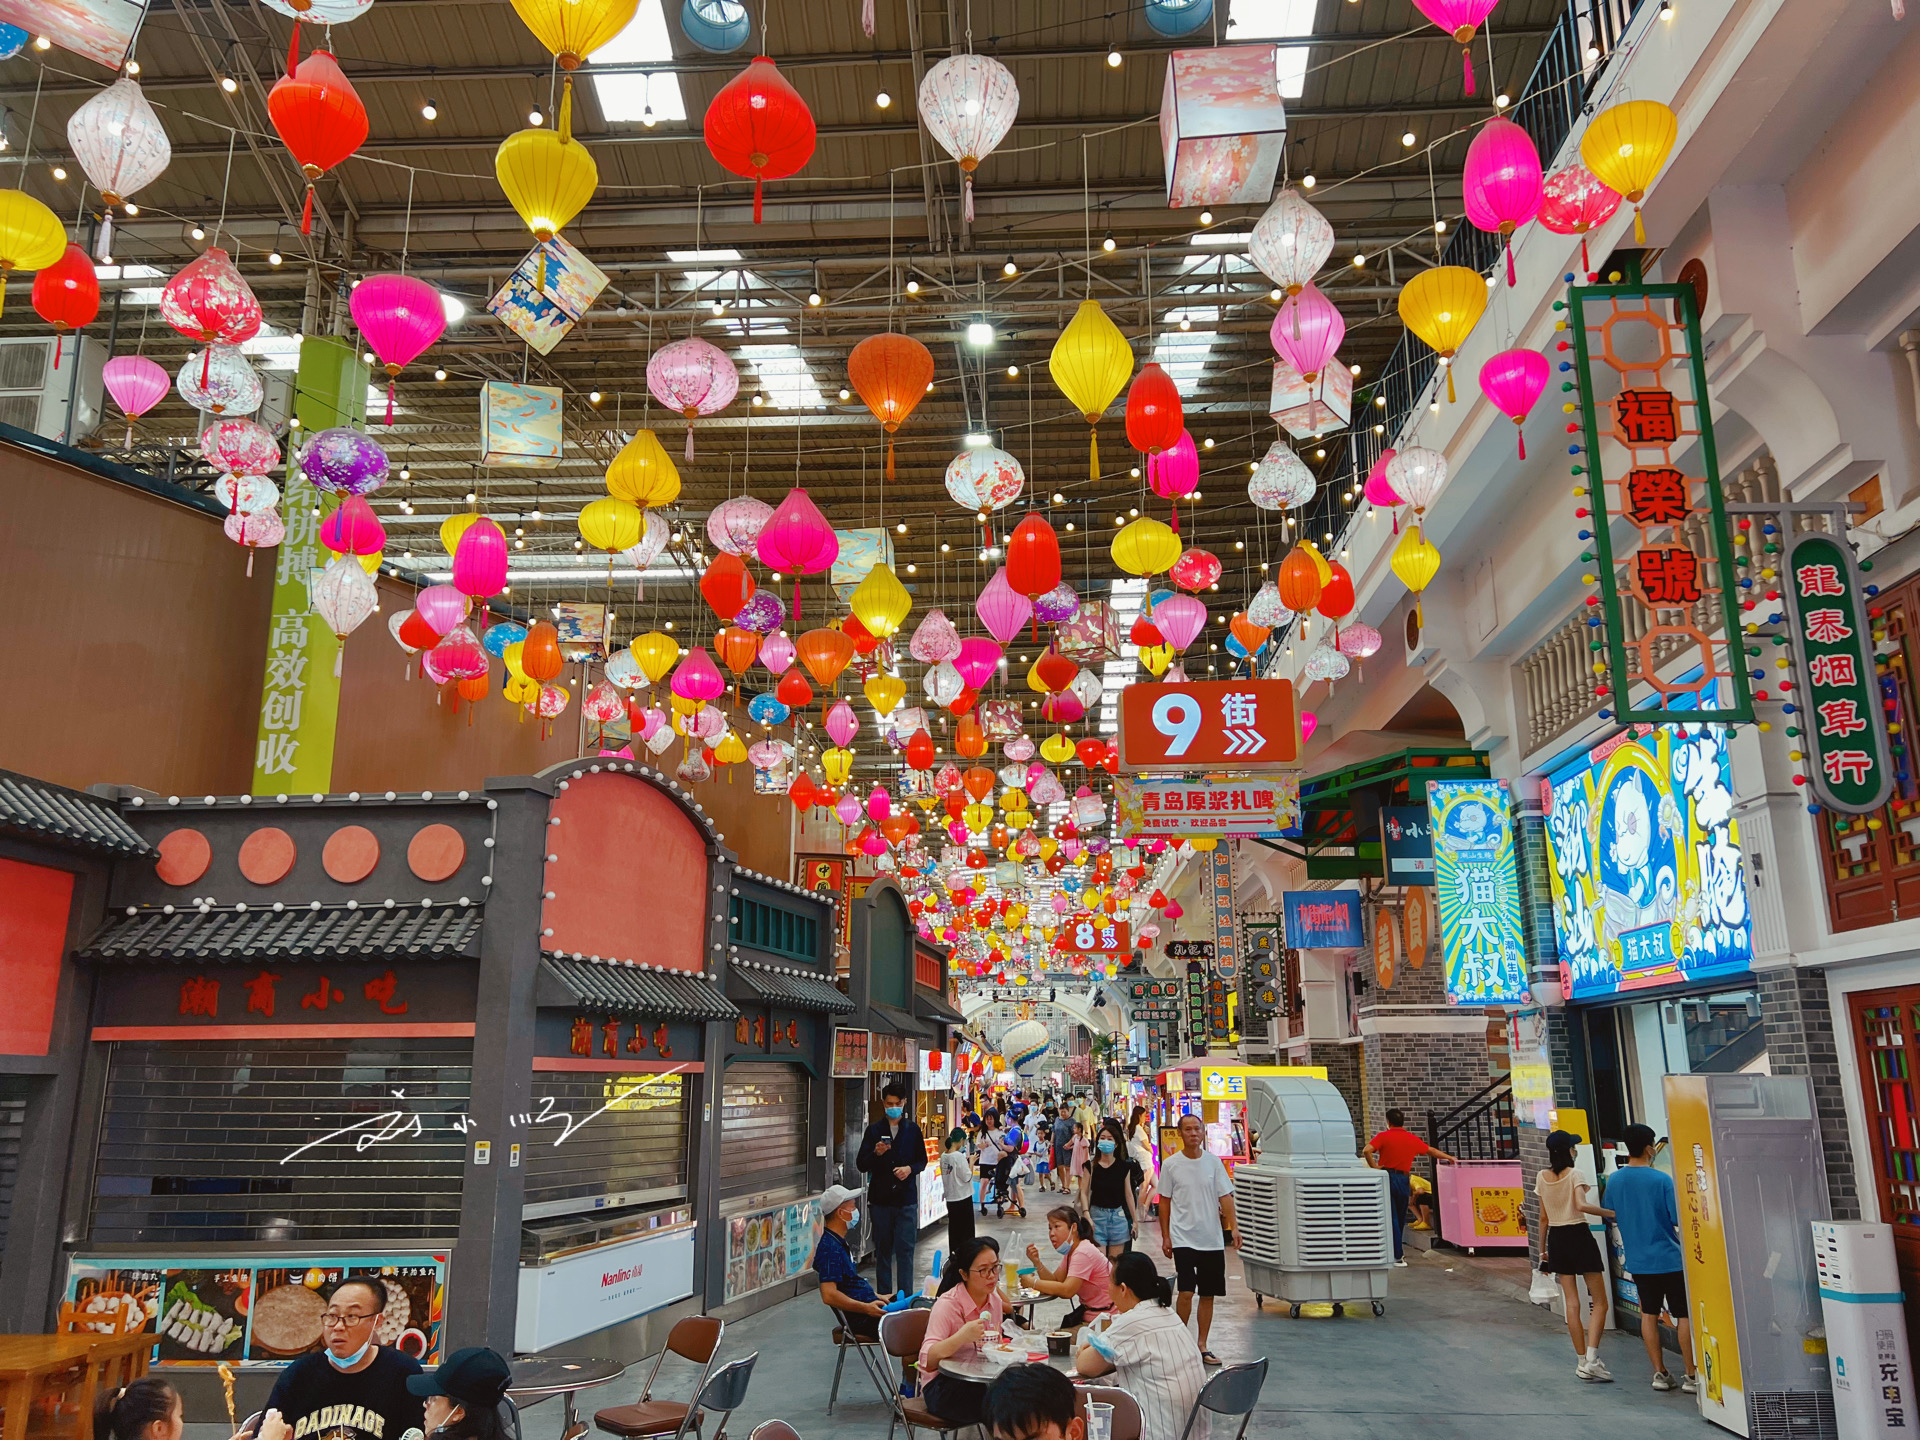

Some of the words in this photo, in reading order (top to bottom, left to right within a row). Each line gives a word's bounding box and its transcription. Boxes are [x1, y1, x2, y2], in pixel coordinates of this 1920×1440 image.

[1617, 390, 1701, 604] 福榮號
[256, 608, 312, 775] 高效创收
[1796, 564, 1873, 786] 龍泰烟草行
[1152, 693, 1202, 756] 9
[1221, 692, 1258, 727] 街
[1142, 790, 1275, 812] 青岛原浆扎啤
[1143, 818, 1180, 828] 免费试饮
[1190, 818, 1228, 828] 欢迎品尝
[1454, 867, 1504, 988] 猫大叔
[1496, 868, 1513, 938] MAODASHU
[1075, 922, 1096, 950] 8
[1627, 932, 1665, 962] 猫大叔
[1484, 1225, 1499, 1234] 9.9
[601, 1268, 632, 1288] Nanling
[1879, 1363, 1906, 1427] 充电宝
[294, 1403, 386, 1440] BADINAGE
